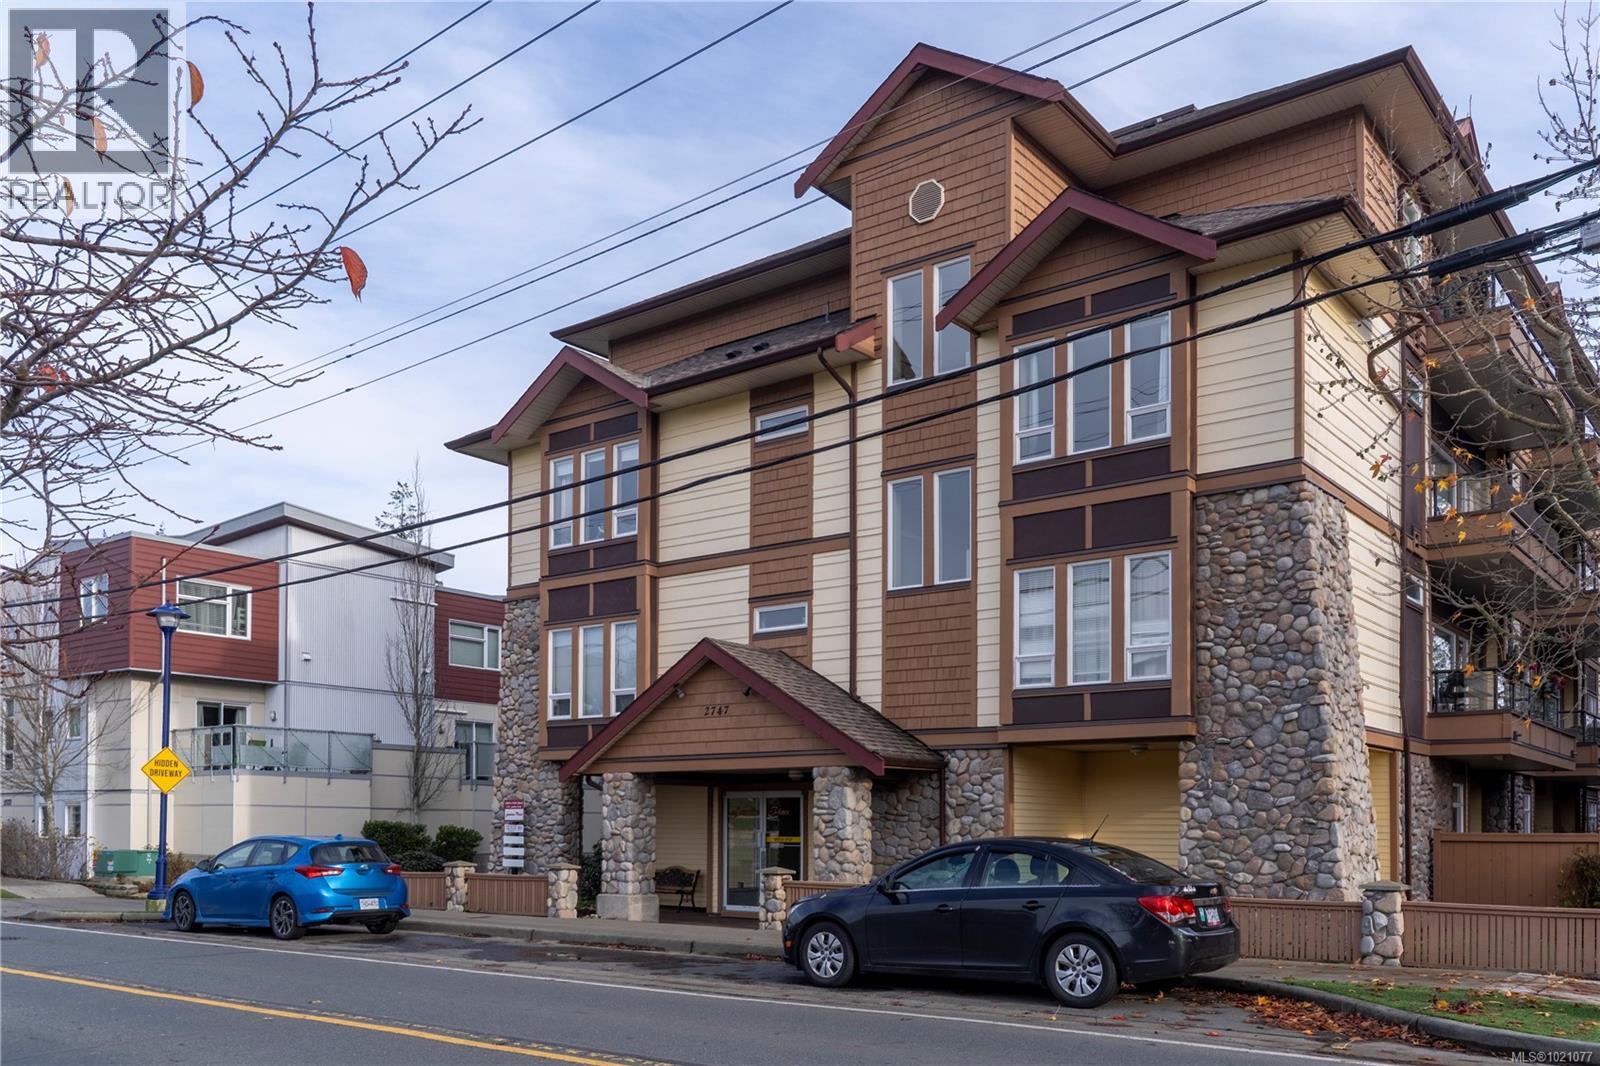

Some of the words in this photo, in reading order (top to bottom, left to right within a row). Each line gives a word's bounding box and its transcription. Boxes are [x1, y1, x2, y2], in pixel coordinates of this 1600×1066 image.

[704, 705, 729, 716] 2747
[154, 759, 179, 768] HIDDEN
[149, 768, 183, 778] DRIVEWAY
